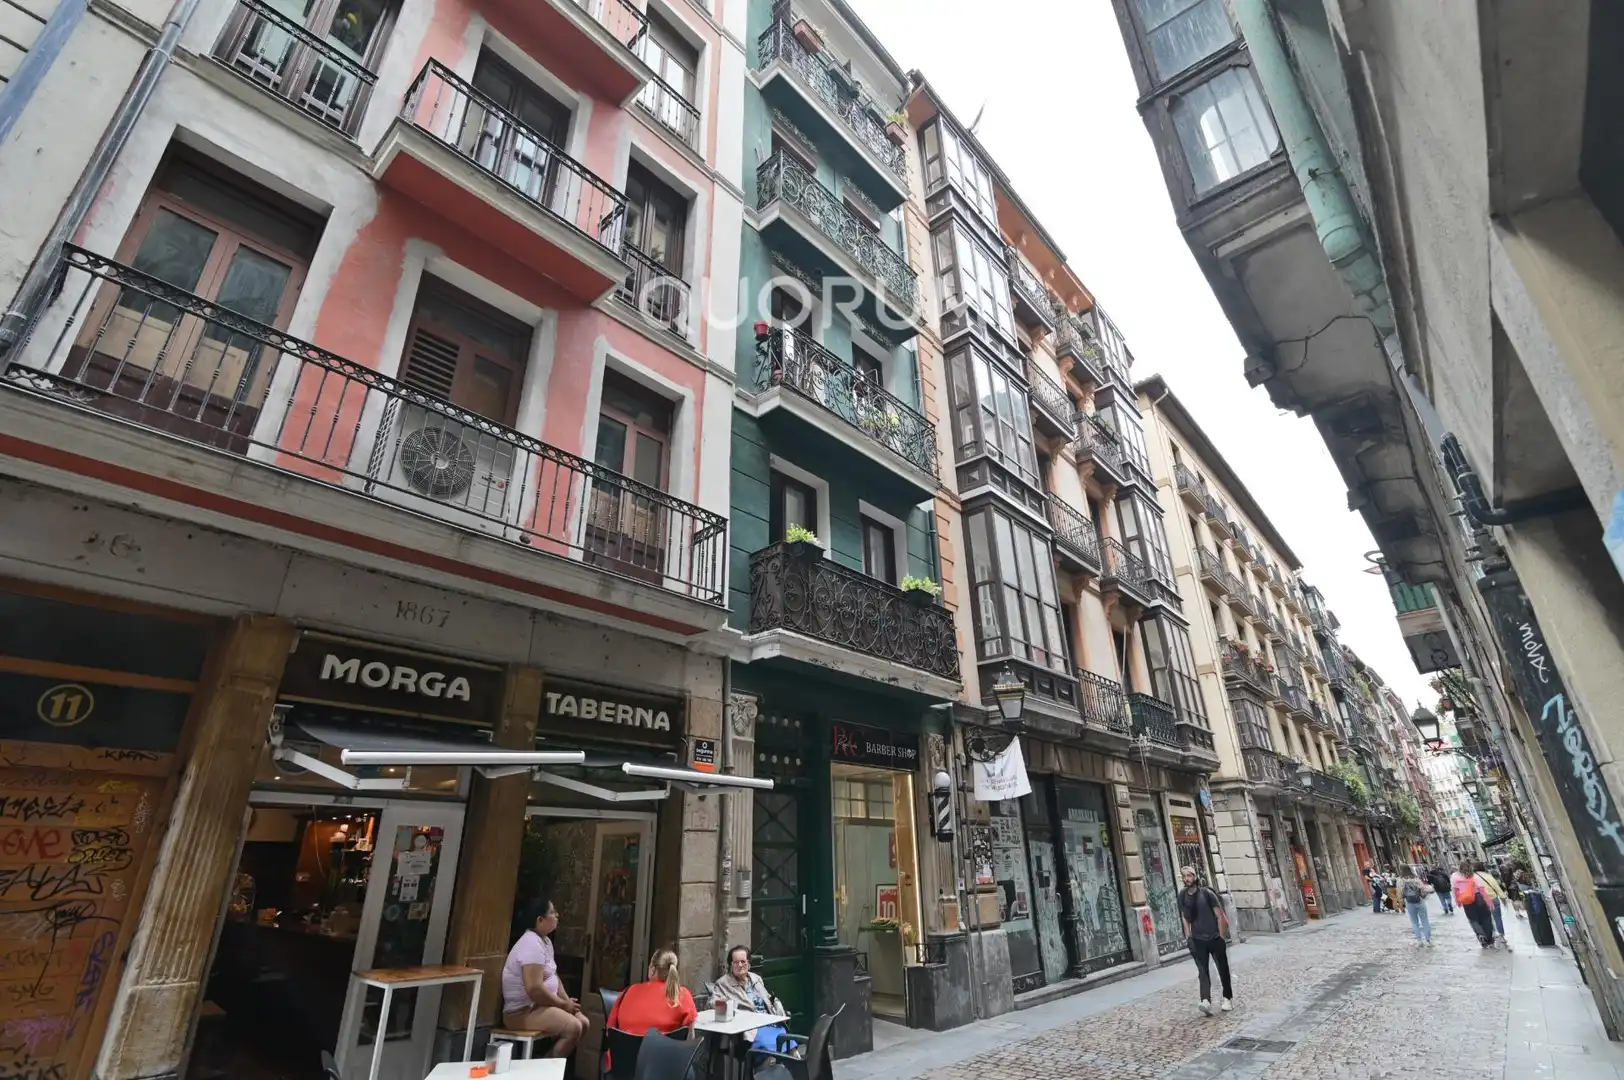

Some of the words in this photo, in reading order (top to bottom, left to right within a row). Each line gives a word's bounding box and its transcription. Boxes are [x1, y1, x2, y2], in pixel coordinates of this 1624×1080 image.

[395, 600, 451, 628] 1867
[319, 653, 471, 702] MORGA
[49, 692, 83, 720] 11
[546, 691, 671, 732] TABERNA
[865, 741, 897, 757] BARBER
[881, 901, 897, 918] 10
